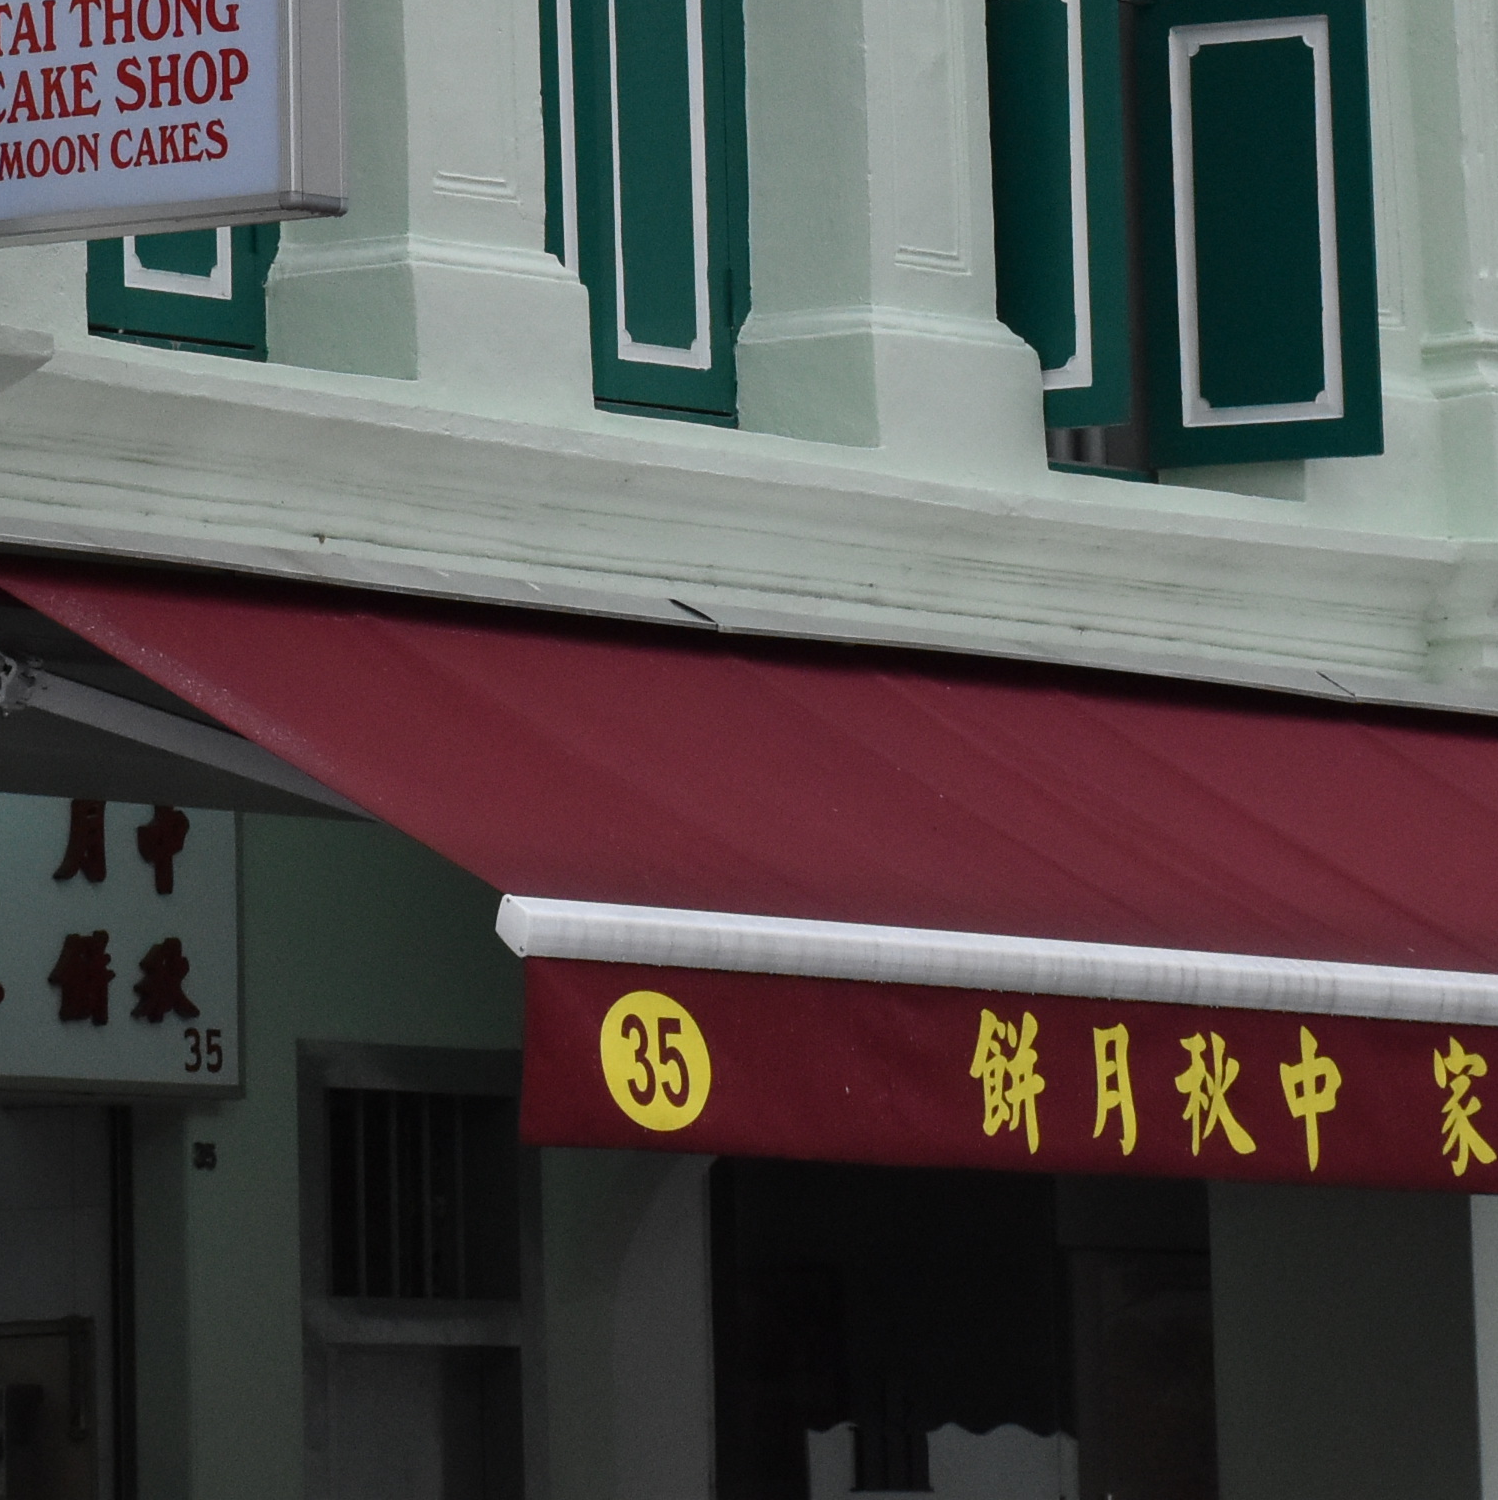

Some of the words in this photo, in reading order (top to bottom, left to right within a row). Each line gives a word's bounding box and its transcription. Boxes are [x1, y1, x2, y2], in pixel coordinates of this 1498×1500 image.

[115, 48, 250, 114] SHOP
[110, 119, 229, 170] CAKES
[183, 1027, 223, 1073] 35
[620, 1012, 691, 1108] 35
